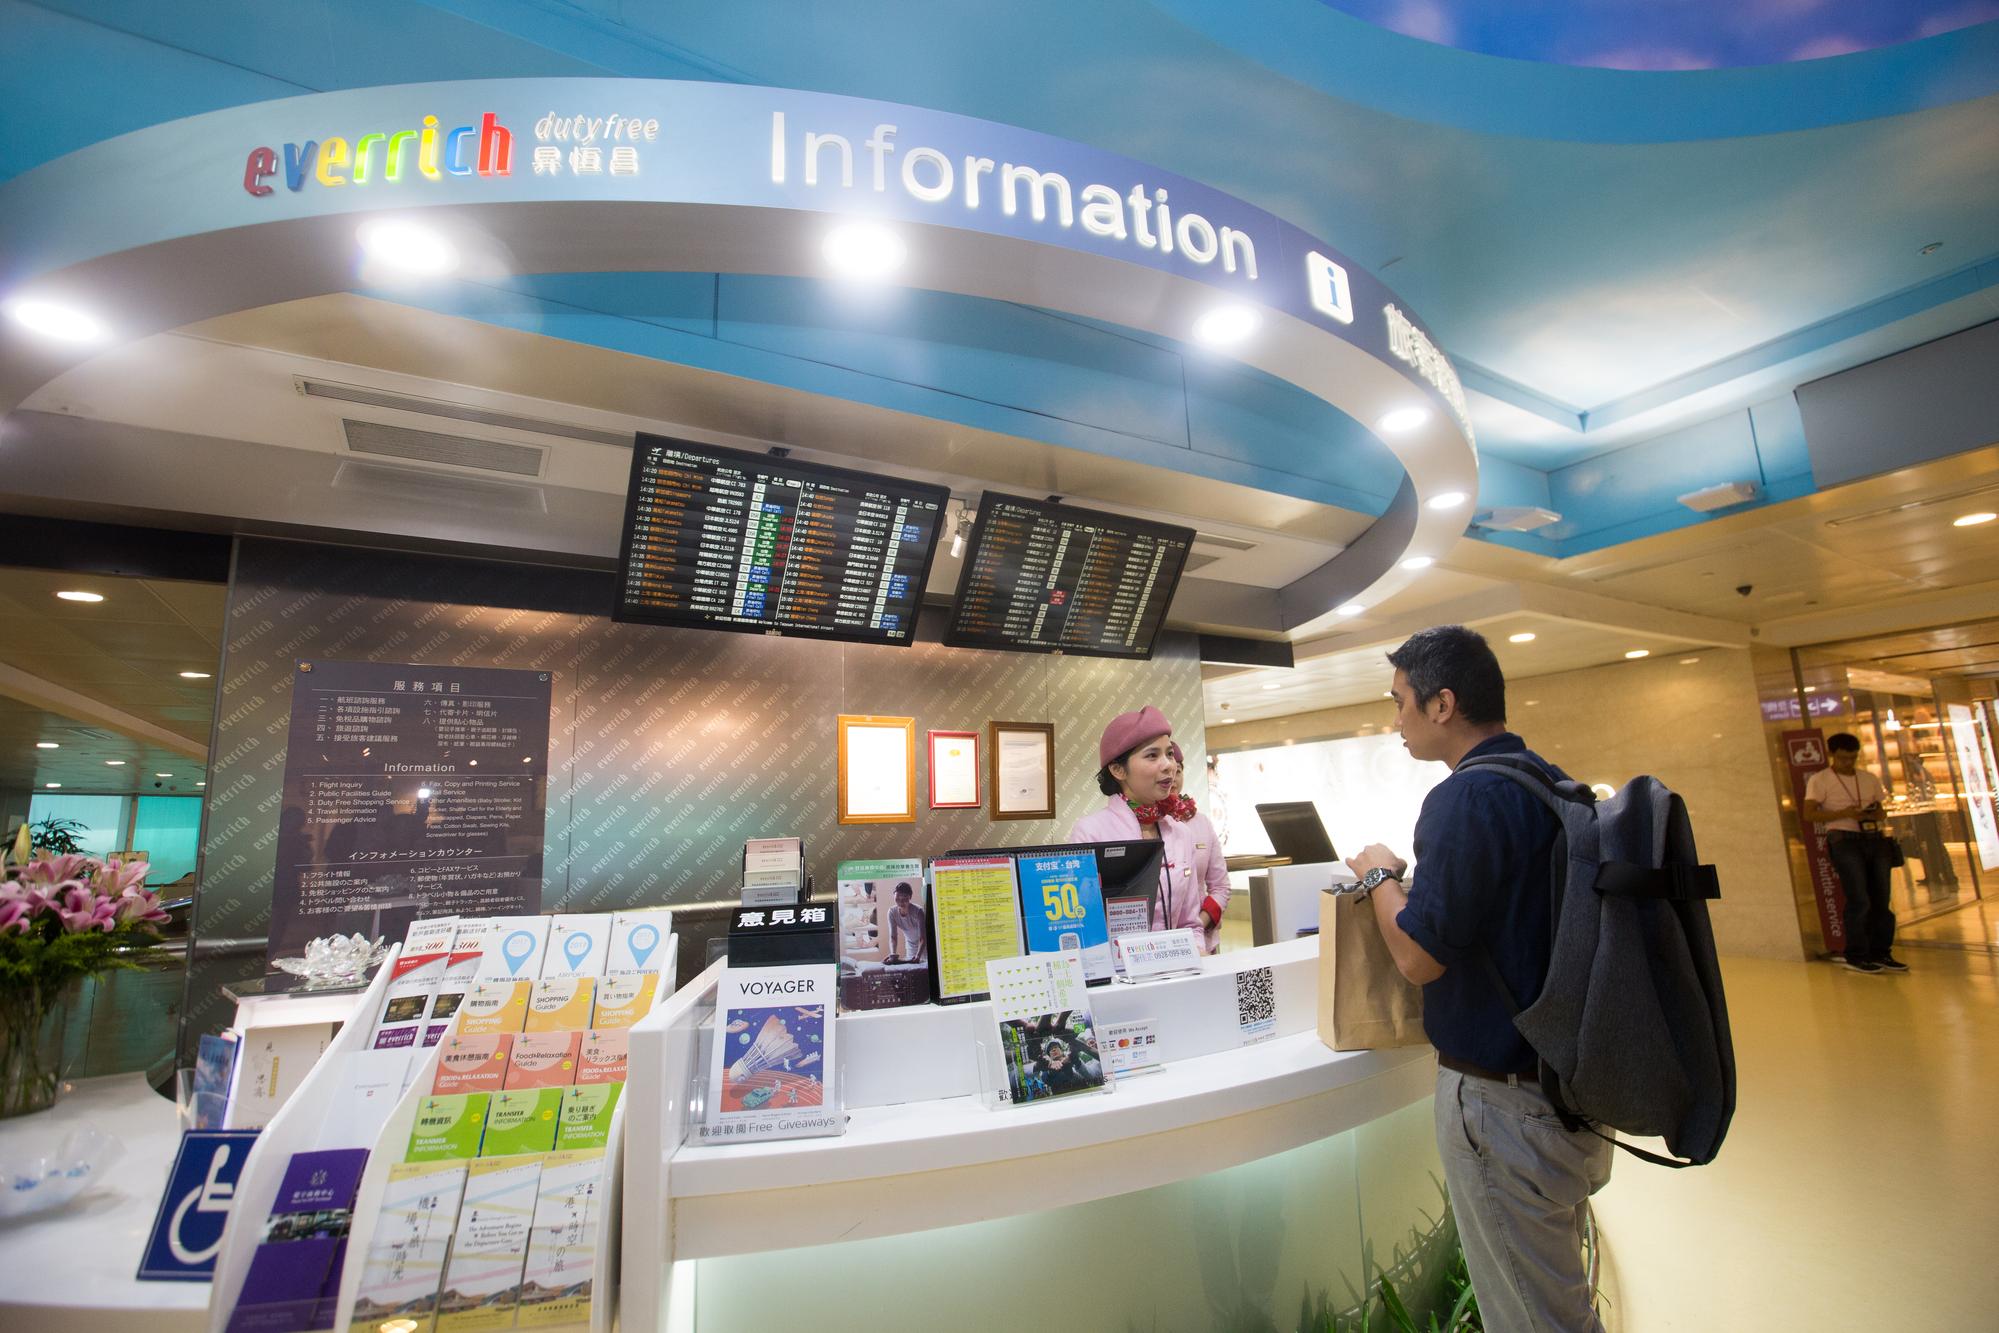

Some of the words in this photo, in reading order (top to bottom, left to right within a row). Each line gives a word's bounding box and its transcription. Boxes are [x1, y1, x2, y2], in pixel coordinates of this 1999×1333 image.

[243, 112, 515, 197] everrich
[770, 110, 1258, 280] Information
[231, 585, 279, 619] everrich
[393, 680, 460, 693] 服務項目
[565, 675, 598, 704] everrich
[217, 697, 264, 731] everrich
[599, 708, 631, 738] everrich
[667, 710, 698, 739] everrich
[700, 709, 729, 736] everrich
[384, 763, 456, 772] Information
[598, 739, 630, 769] everrich
[560, 772, 593, 803] everrich
[631, 772, 663, 802] everrich
[698, 770, 728, 801] everrich
[593, 804, 627, 837] everrich
[348, 848, 483, 861] インフォメーションカウンター
[556, 841, 590, 873] everrich
[1817, 857, 1835, 896] shuttle
[1042, 883, 1079, 921] 50
[737, 907, 827, 928] 意見箱
[1824, 898, 1841, 937] service
[740, 979, 815, 995] VOYAGER
[470, 1000, 498, 1008] 購物指南
[445, 1053, 489, 1063] 美食休憩指南
[494, 1117, 535, 1125] INFORMATION
[748, 1122, 772, 1133] Free
[778, 1116, 835, 1130] Giveaways
